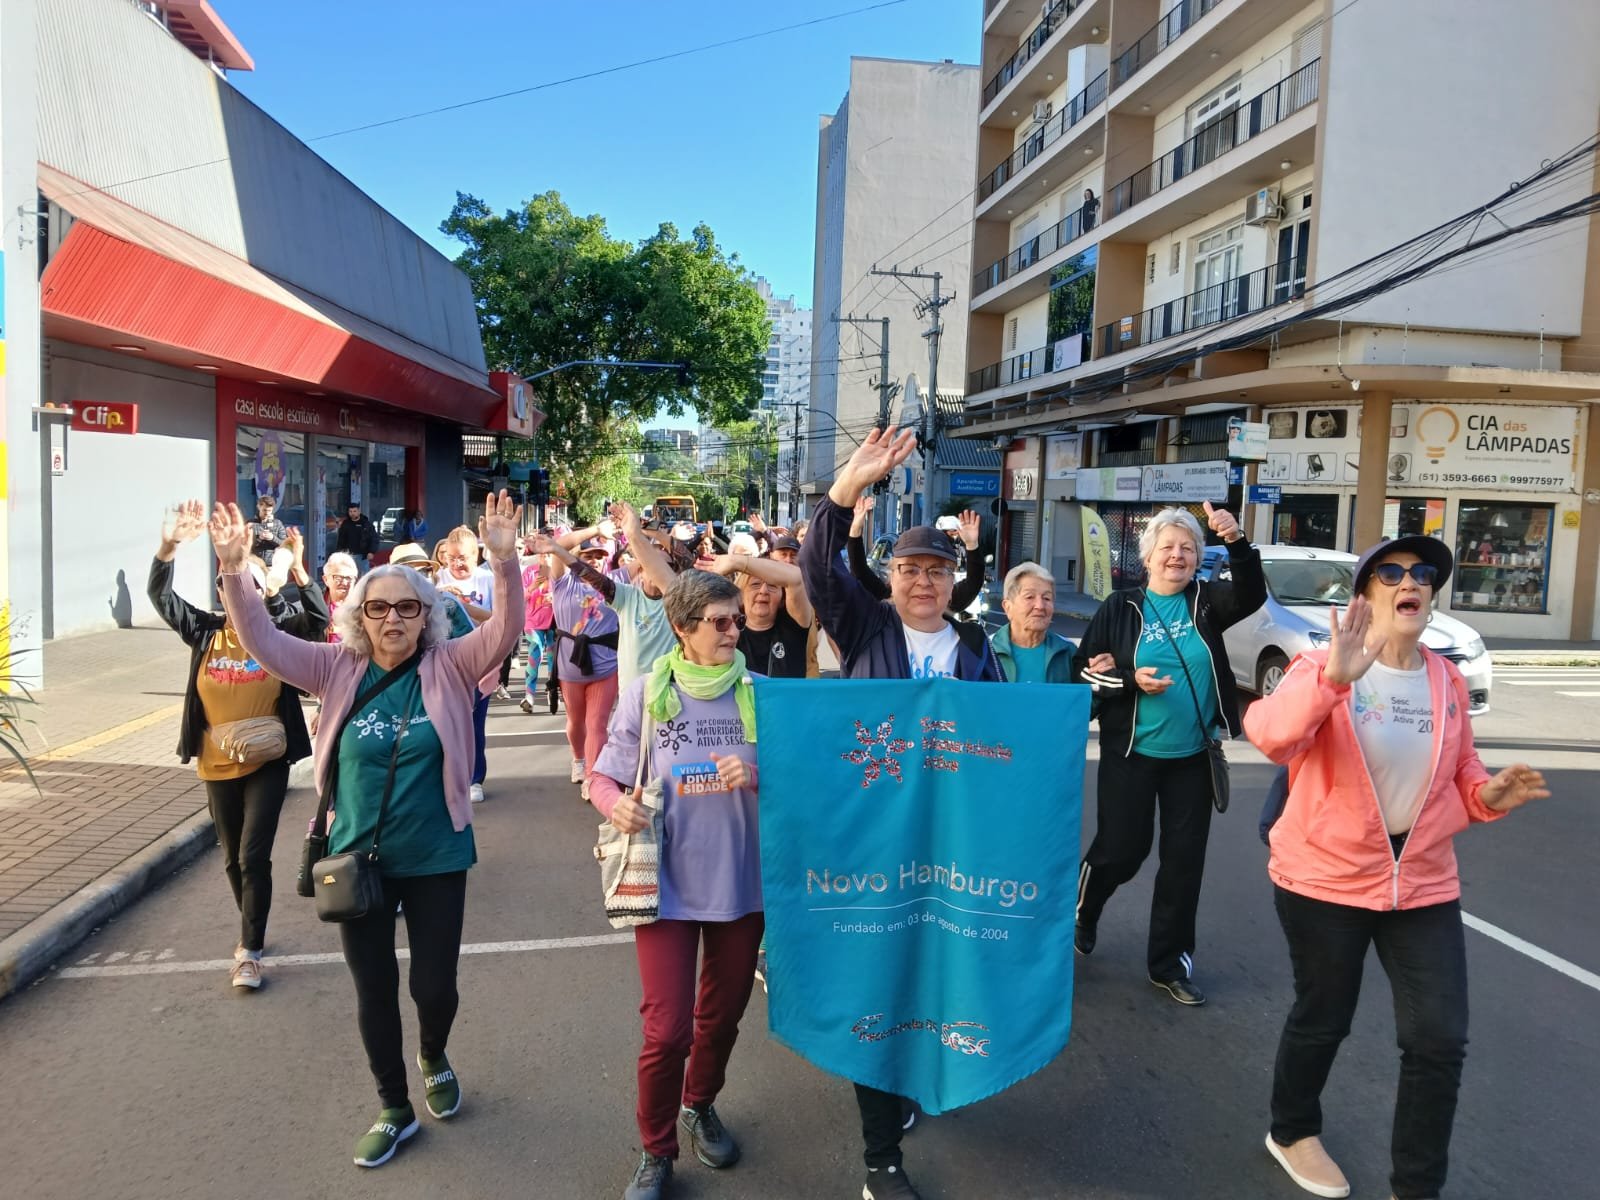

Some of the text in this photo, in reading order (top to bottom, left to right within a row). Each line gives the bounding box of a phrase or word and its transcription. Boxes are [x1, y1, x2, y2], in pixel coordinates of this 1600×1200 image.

[235, 398, 254, 416] casa
[259, 401, 284, 420] escola
[1467, 415, 1528, 432] CIA das
[1466, 431, 1571, 454] LÂMPADAS
[1418, 473, 1439, 483] (51)
[1442, 473, 1497, 483] 3593-6663
[696, 726, 744, 736] MATURIDADE
[697, 735, 745, 747] ATIVA SESC
[680, 765, 710, 775] VIVA A
[684, 782, 729, 794] SIDADE
[806, 861, 1039, 907] Novo Hamburgo
[833, 911, 1009, 941] Fundado em: 03 de agosto de 2004
[425, 1070, 454, 1088] SCHUTZ
